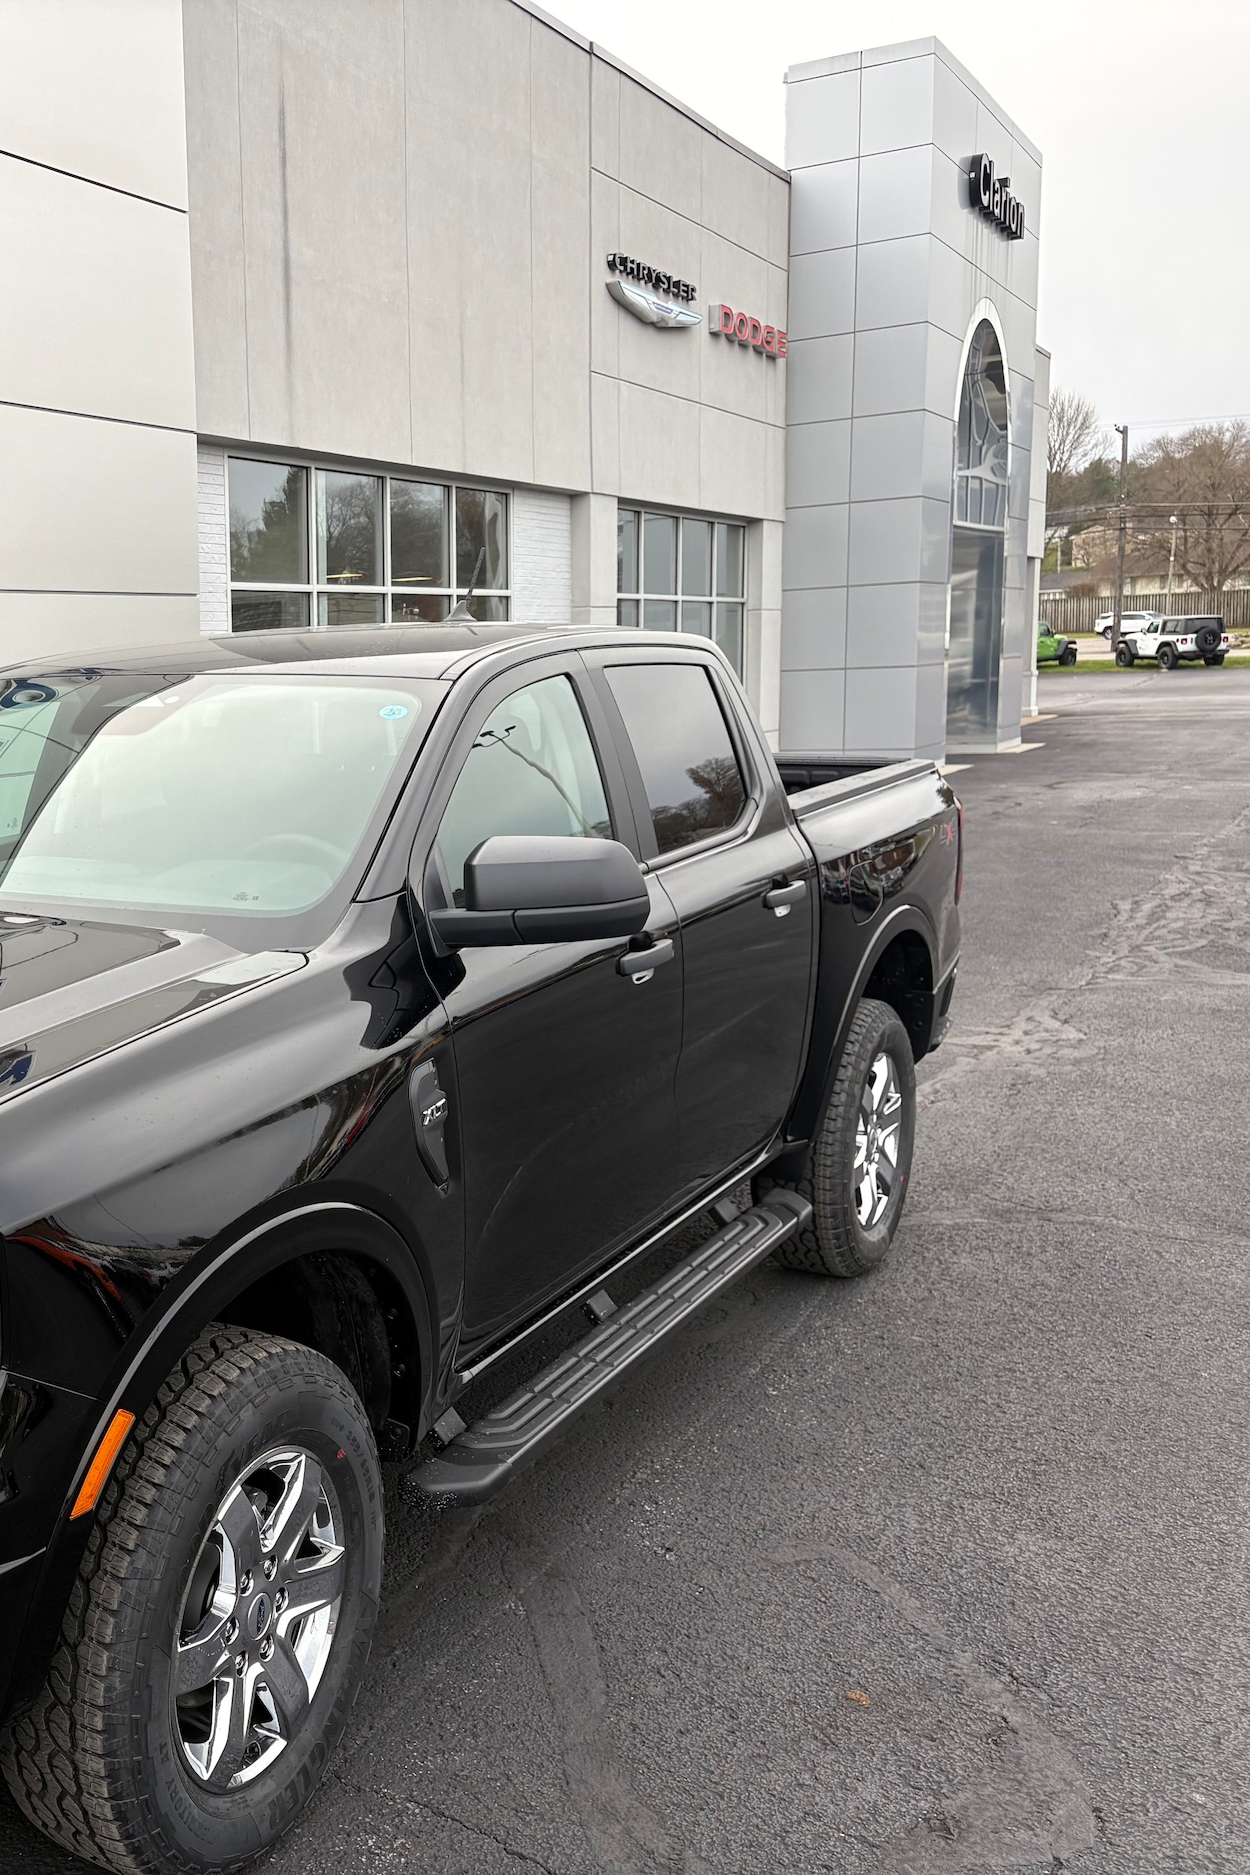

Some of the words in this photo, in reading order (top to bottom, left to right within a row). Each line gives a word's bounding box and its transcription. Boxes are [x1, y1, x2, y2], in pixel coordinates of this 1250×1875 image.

[969, 153, 1025, 240] Clarion
[606, 252, 698, 302] CHRYSLER
[709, 304, 788, 359] DODGE
[422, 1098, 446, 1126] XLT
